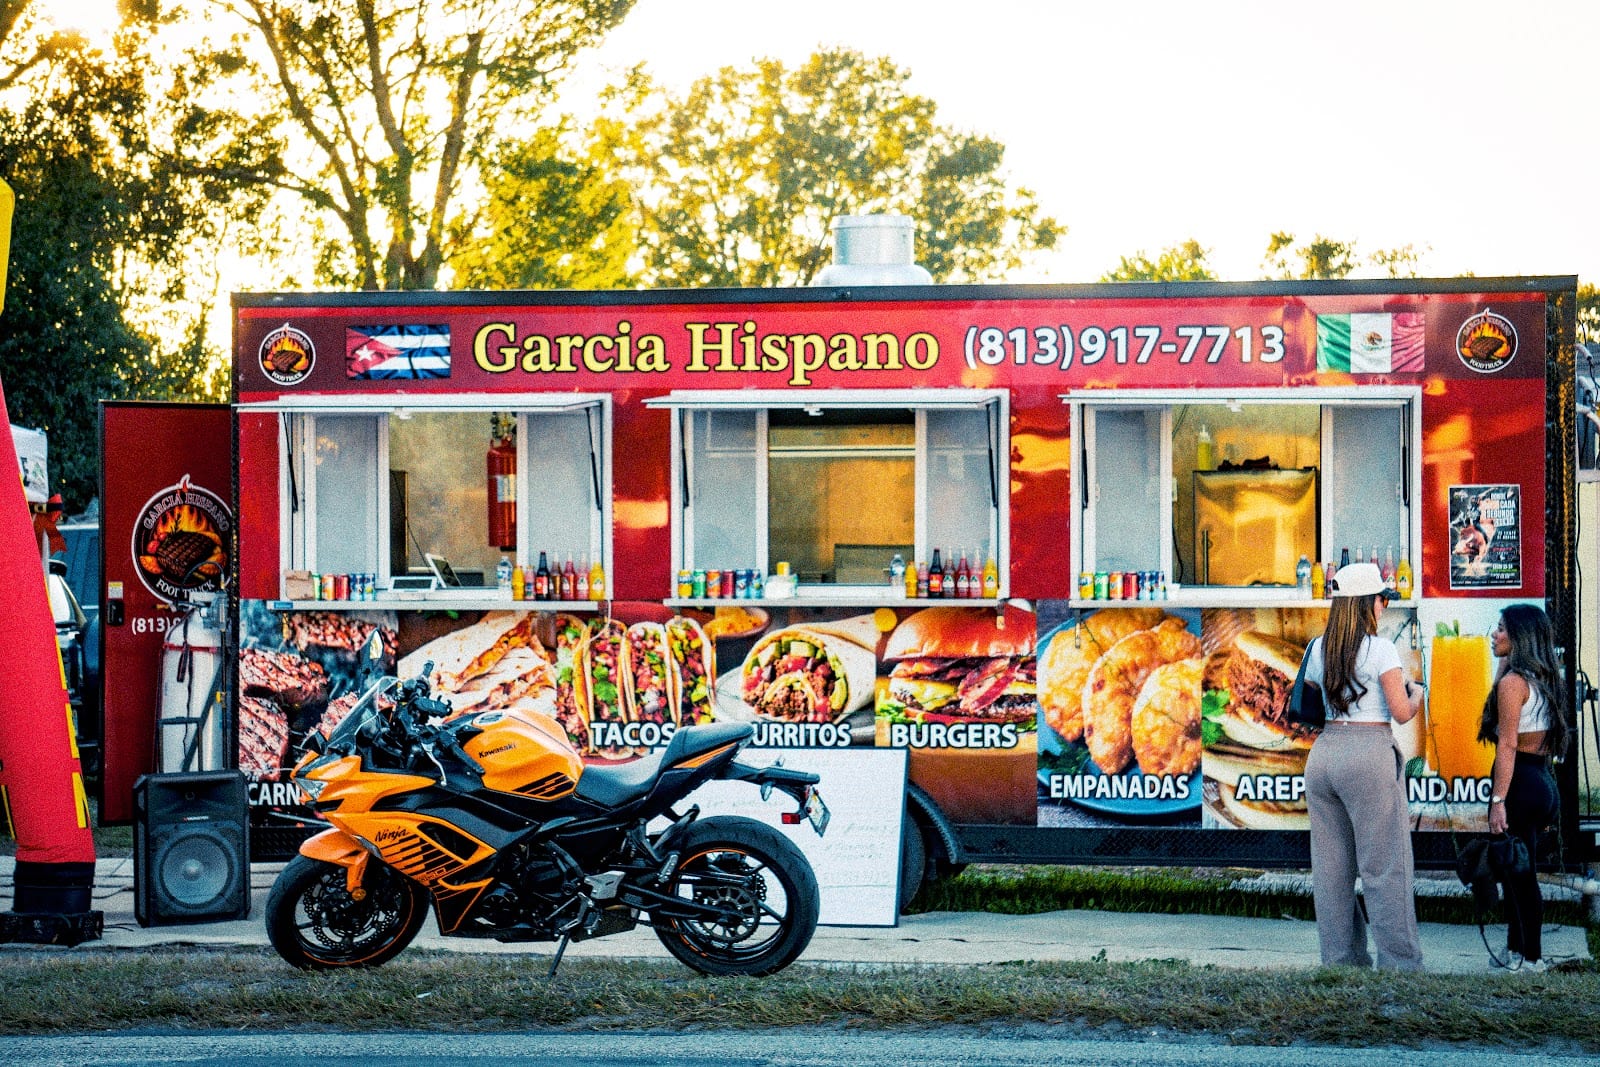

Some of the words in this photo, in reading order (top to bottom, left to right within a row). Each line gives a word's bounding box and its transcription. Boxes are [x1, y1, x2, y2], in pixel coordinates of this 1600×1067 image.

[473, 320, 670, 374] Garcia
[685, 320, 940, 386] Hispano
[964, 325, 1285, 370] (813)917-7713
[143, 493, 183, 531] GARCIA
[185, 493, 230, 533] HISPANO
[590, 722, 676, 747] TACOS
[751, 722, 852, 747] URRITOS
[891, 723, 1018, 748] BURGERS
[478, 743, 517, 759] Kawasaki
[248, 782, 305, 806] CARN
[1050, 774, 1190, 800] EMPANADAS
[1236, 776, 1306, 801] AREP
[1408, 777, 1447, 802] ND
[1453, 777, 1493, 802] MO
[375, 825, 409, 843] Ninja
